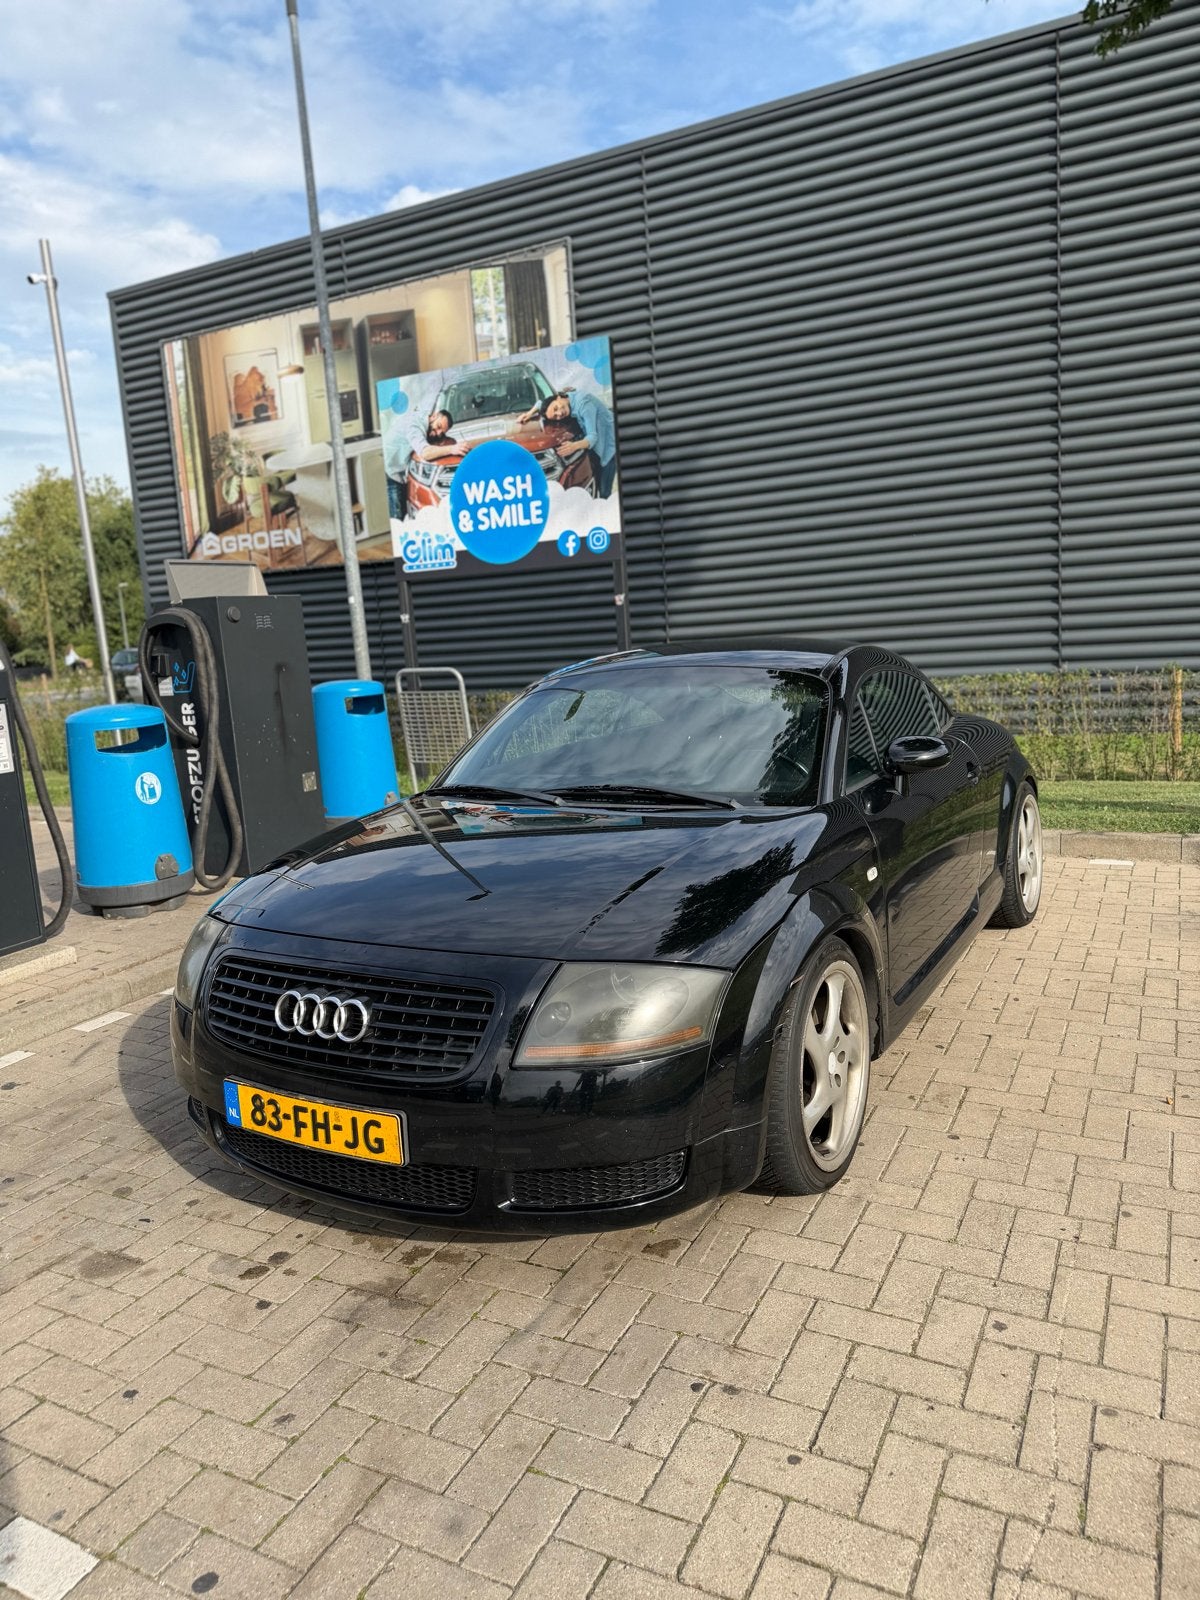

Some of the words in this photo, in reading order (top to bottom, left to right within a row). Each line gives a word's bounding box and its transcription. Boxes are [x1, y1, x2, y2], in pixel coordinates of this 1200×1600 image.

[463, 473, 533, 506] WASH
[458, 509, 474, 533] &
[477, 500, 544, 532] SMILE
[221, 526, 303, 554] GROEN
[402, 538, 455, 564] Glim
[228, 1106, 240, 1119] NL
[250, 1093, 386, 1155] 83-FH-JG
